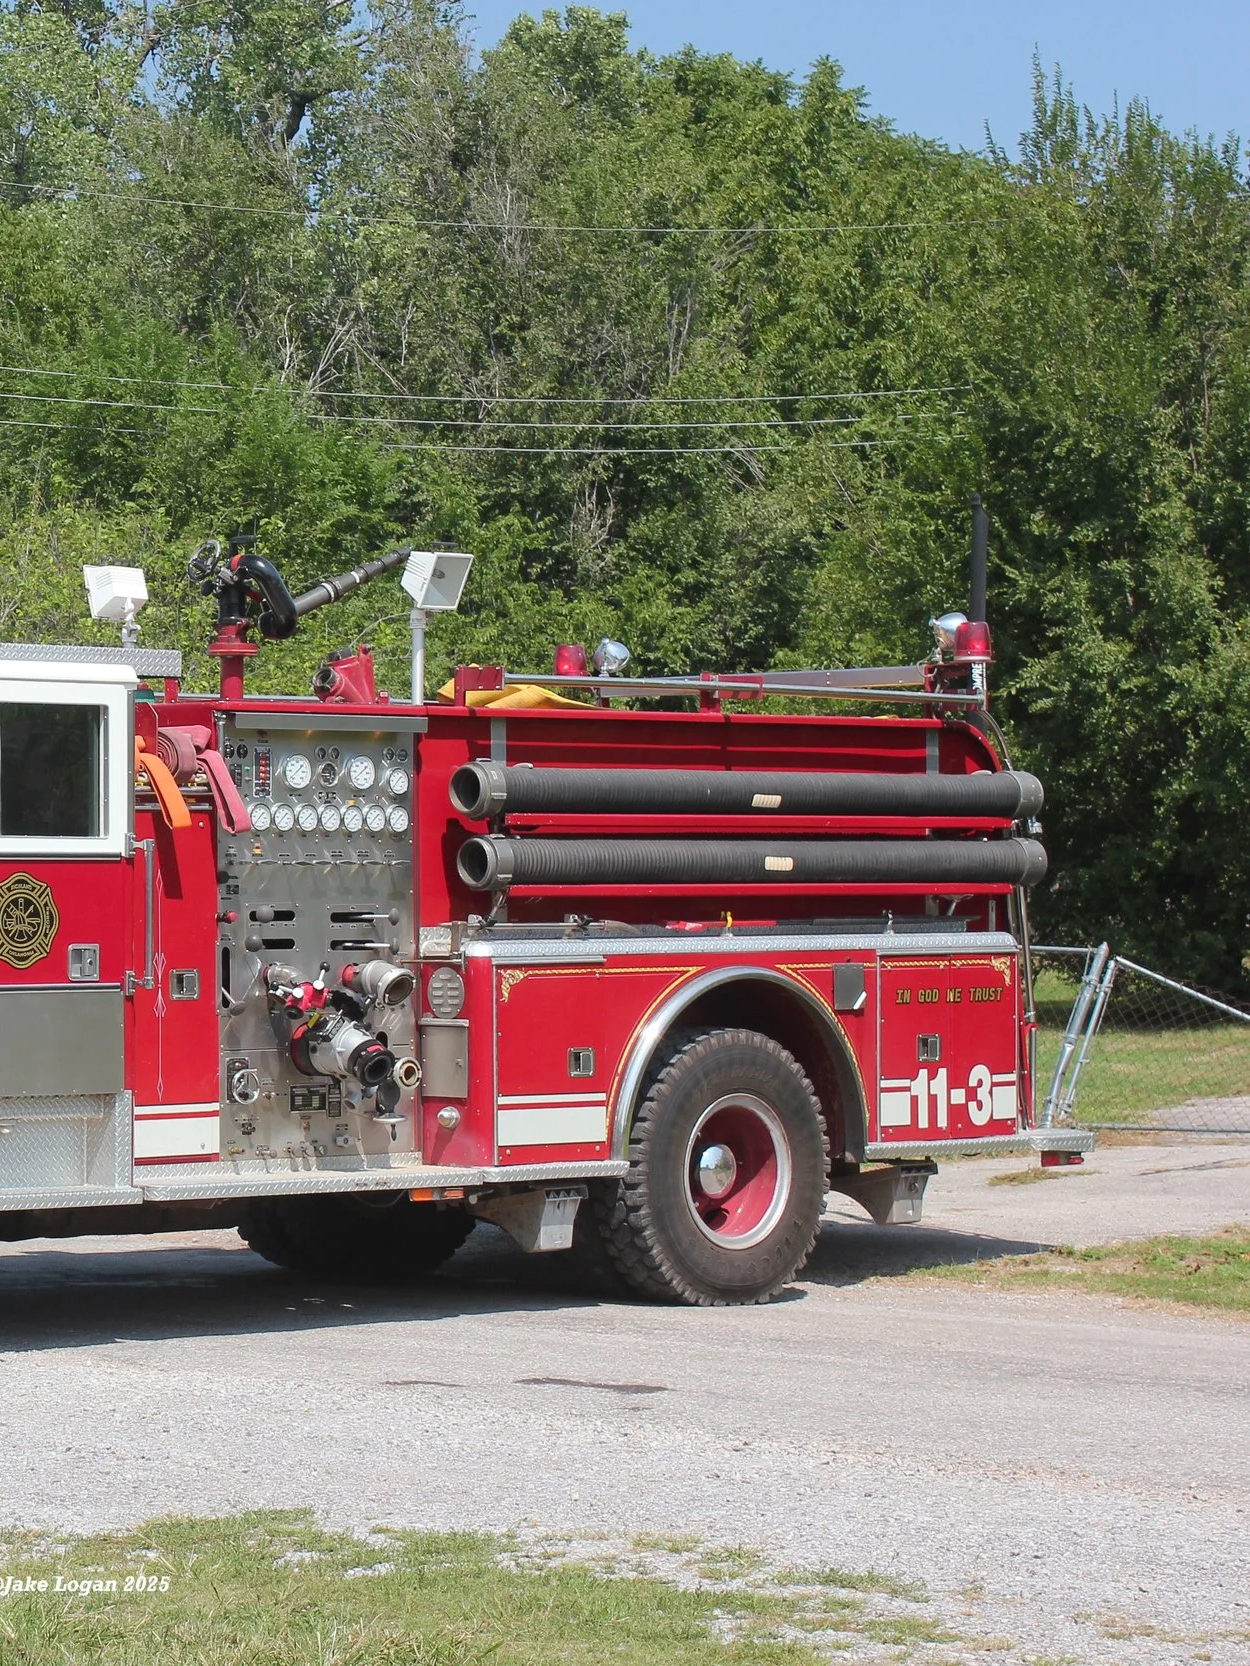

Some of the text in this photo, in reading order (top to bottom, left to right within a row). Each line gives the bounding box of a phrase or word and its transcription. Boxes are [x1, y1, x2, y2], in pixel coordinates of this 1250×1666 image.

[895, 989, 911, 1004] IN
[918, 988, 939, 1003] GOD
[969, 987, 1003, 1002] TRUST
[911, 1064, 992, 1129] 11-3
